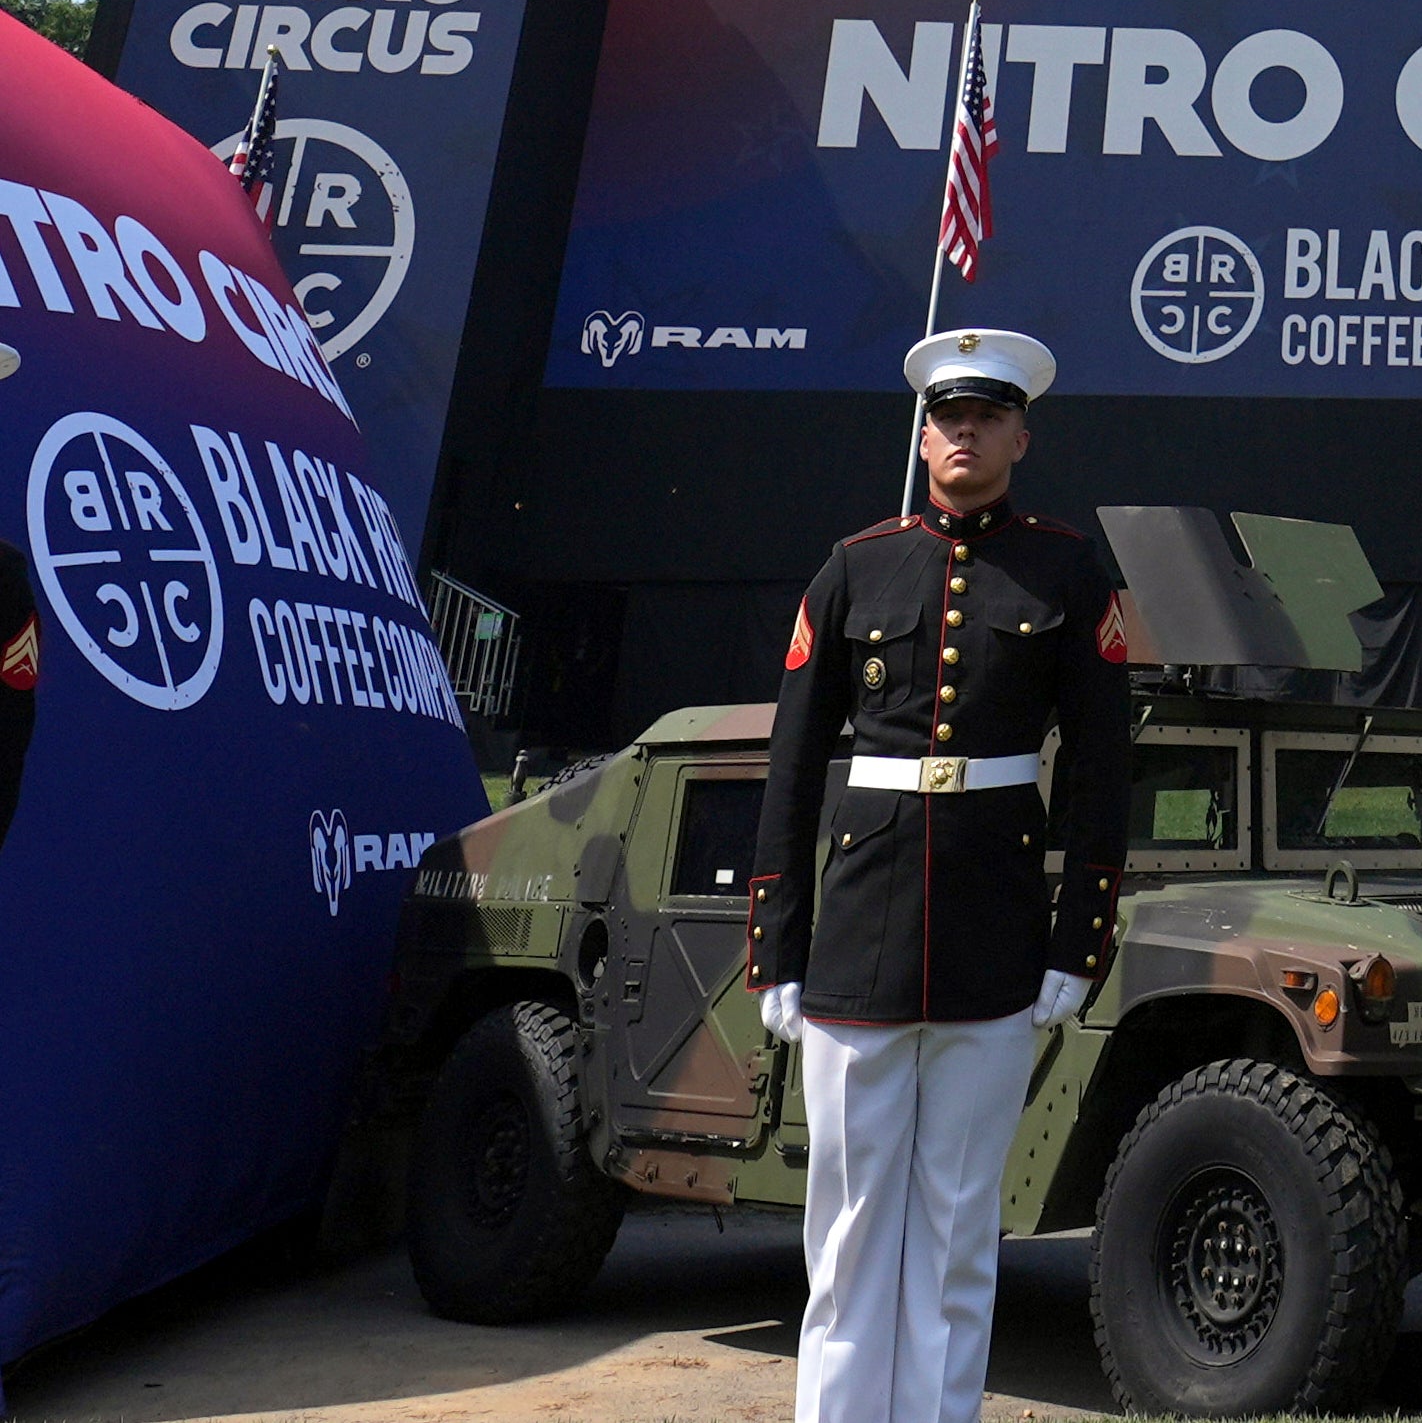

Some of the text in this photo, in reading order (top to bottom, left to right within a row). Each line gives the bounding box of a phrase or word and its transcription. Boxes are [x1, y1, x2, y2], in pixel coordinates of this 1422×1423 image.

[169, 2, 482, 75] CIRCUS
[0, 179, 207, 343] TRO
[650, 325, 808, 349] RAM
[189, 424, 378, 590] BLACK
[249, 597, 386, 710] COFFEE
[354, 832, 436, 872] RAM
